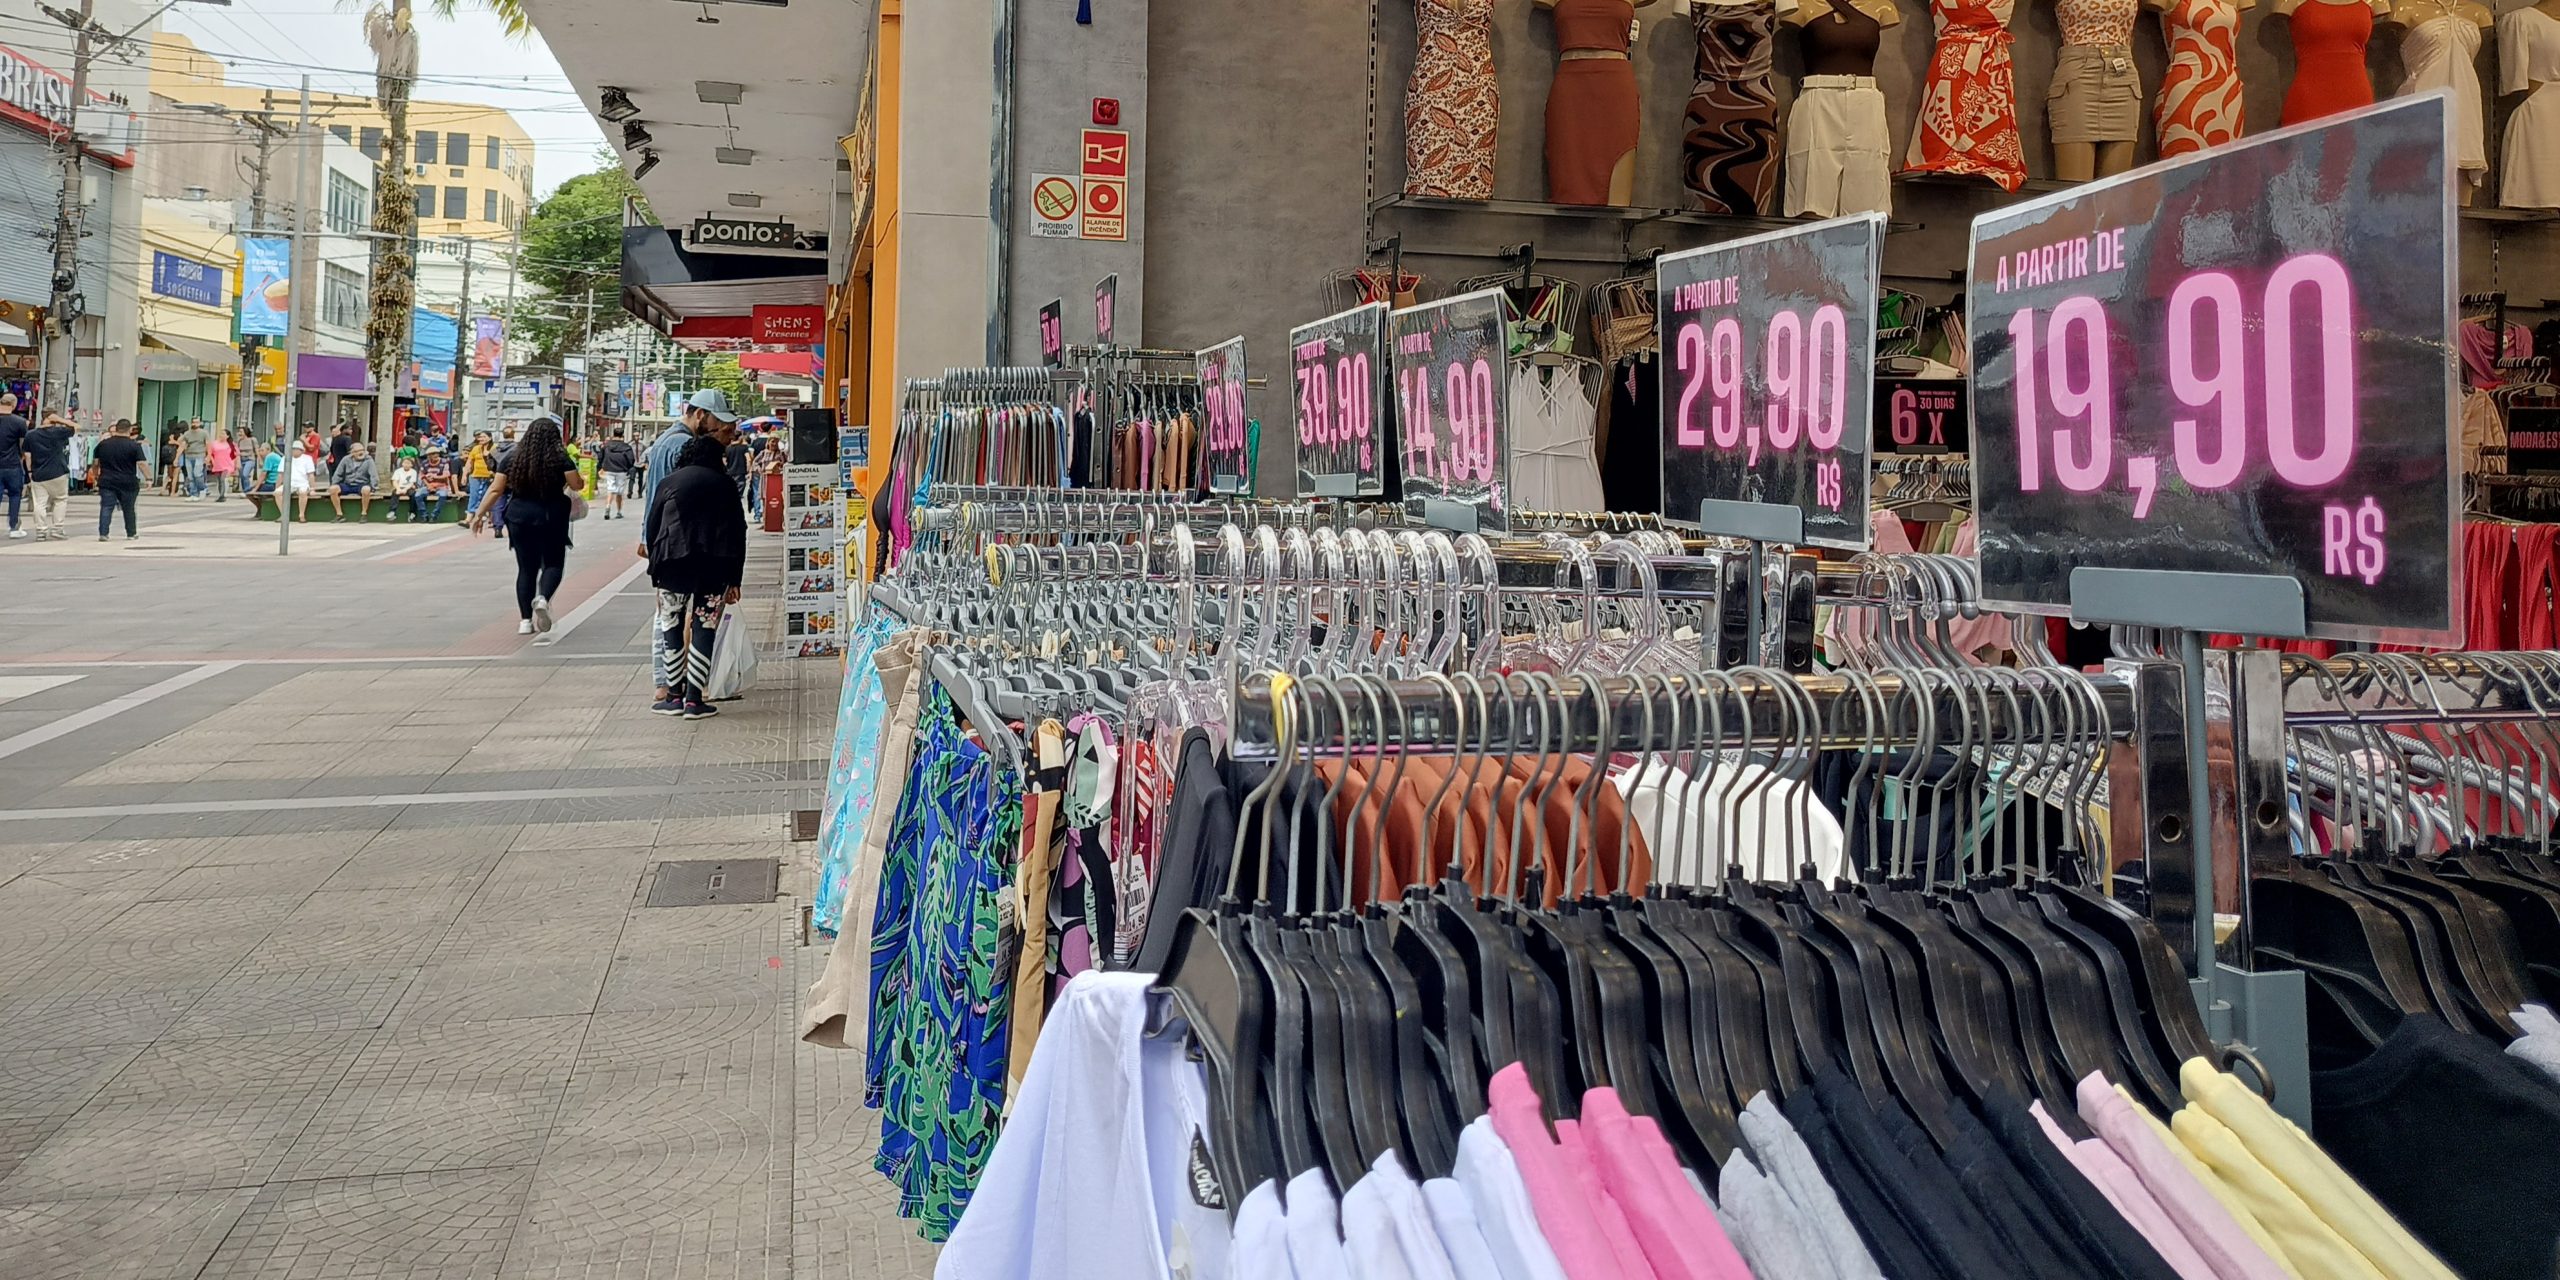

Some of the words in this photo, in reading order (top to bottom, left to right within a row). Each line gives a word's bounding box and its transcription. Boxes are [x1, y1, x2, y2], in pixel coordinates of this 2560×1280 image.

[1038, 222, 1074, 230] PROIBIDO
[1995, 255, 2008, 293] A
[2015, 237, 2088, 289] PARTIR
[2097, 227, 2125, 273] DE
[167, 282, 211, 302] SORVETERIA
[1674, 286, 1682, 312] A
[1684, 279, 1721, 311] PARTIR
[1724, 274, 1739, 304] DE
[764, 330, 809, 338] Presentes
[1301, 340, 1318, 360] PARTIR
[1404, 333, 1422, 354] PARTIR
[1296, 353, 1369, 454] 39,90
[1677, 305, 1846, 466] 29,90
[1920, 397, 1932, 409] 30
[1934, 397, 1955, 409] DIAS
[2008, 254, 2354, 519] 19,90
[1400, 359, 1494, 496] 14,90
[1891, 389, 1917, 444] 6
[1928, 412, 1944, 444] X
[1360, 441, 1371, 472] R$
[2509, 431, 2560, 449] MODA&ES
[1817, 458, 1841, 512] R$
[2323, 497, 2386, 584] R$
